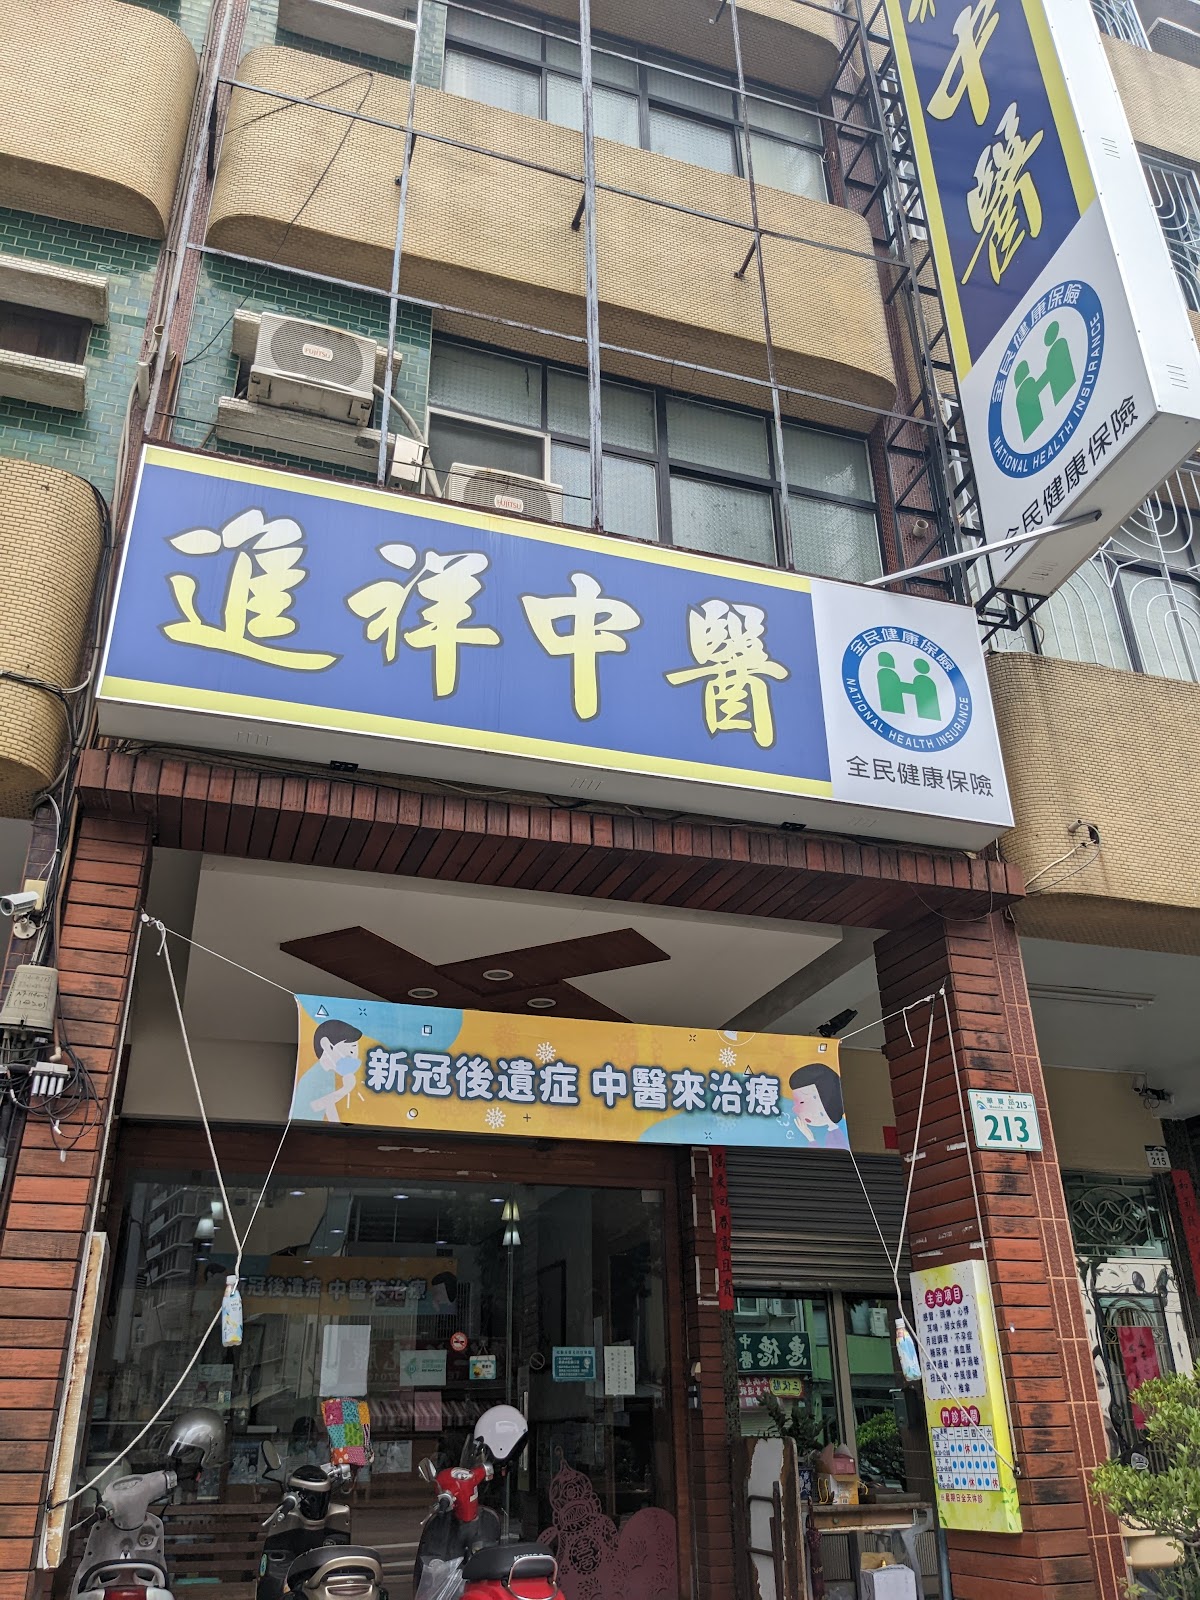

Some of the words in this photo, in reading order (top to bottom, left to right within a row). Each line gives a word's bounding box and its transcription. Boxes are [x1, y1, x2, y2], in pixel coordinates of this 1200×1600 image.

[304, 346, 332, 360] FUJITSU
[992, 283, 1082, 403] 全民健康保險
[992, 435, 1028, 473] NATIONAL
[1032, 422, 1074, 470] HEALTH
[1073, 311, 1100, 417] INSURANCE
[160, 508, 790, 749] 進祥中醫
[850, 627, 956, 673] 全民健康保險
[846, 677, 884, 733] NATIONAL
[889, 729, 935, 749] HEALTH
[936, 696, 969, 747] INSURANCE
[846, 755, 994, 798] 全民健康保險
[366, 1049, 579, 1105] 新冠後遺症
[591, 1064, 781, 1116] 中醫來治療
[1015, 1101, 1028, 1109] 215
[984, 1115, 1029, 1143] 213
[1151, 1157, 1167, 1165] 215
[926, 1287, 961, 1305] 主治項目
[942, 1410, 979, 1425] 門診時間
